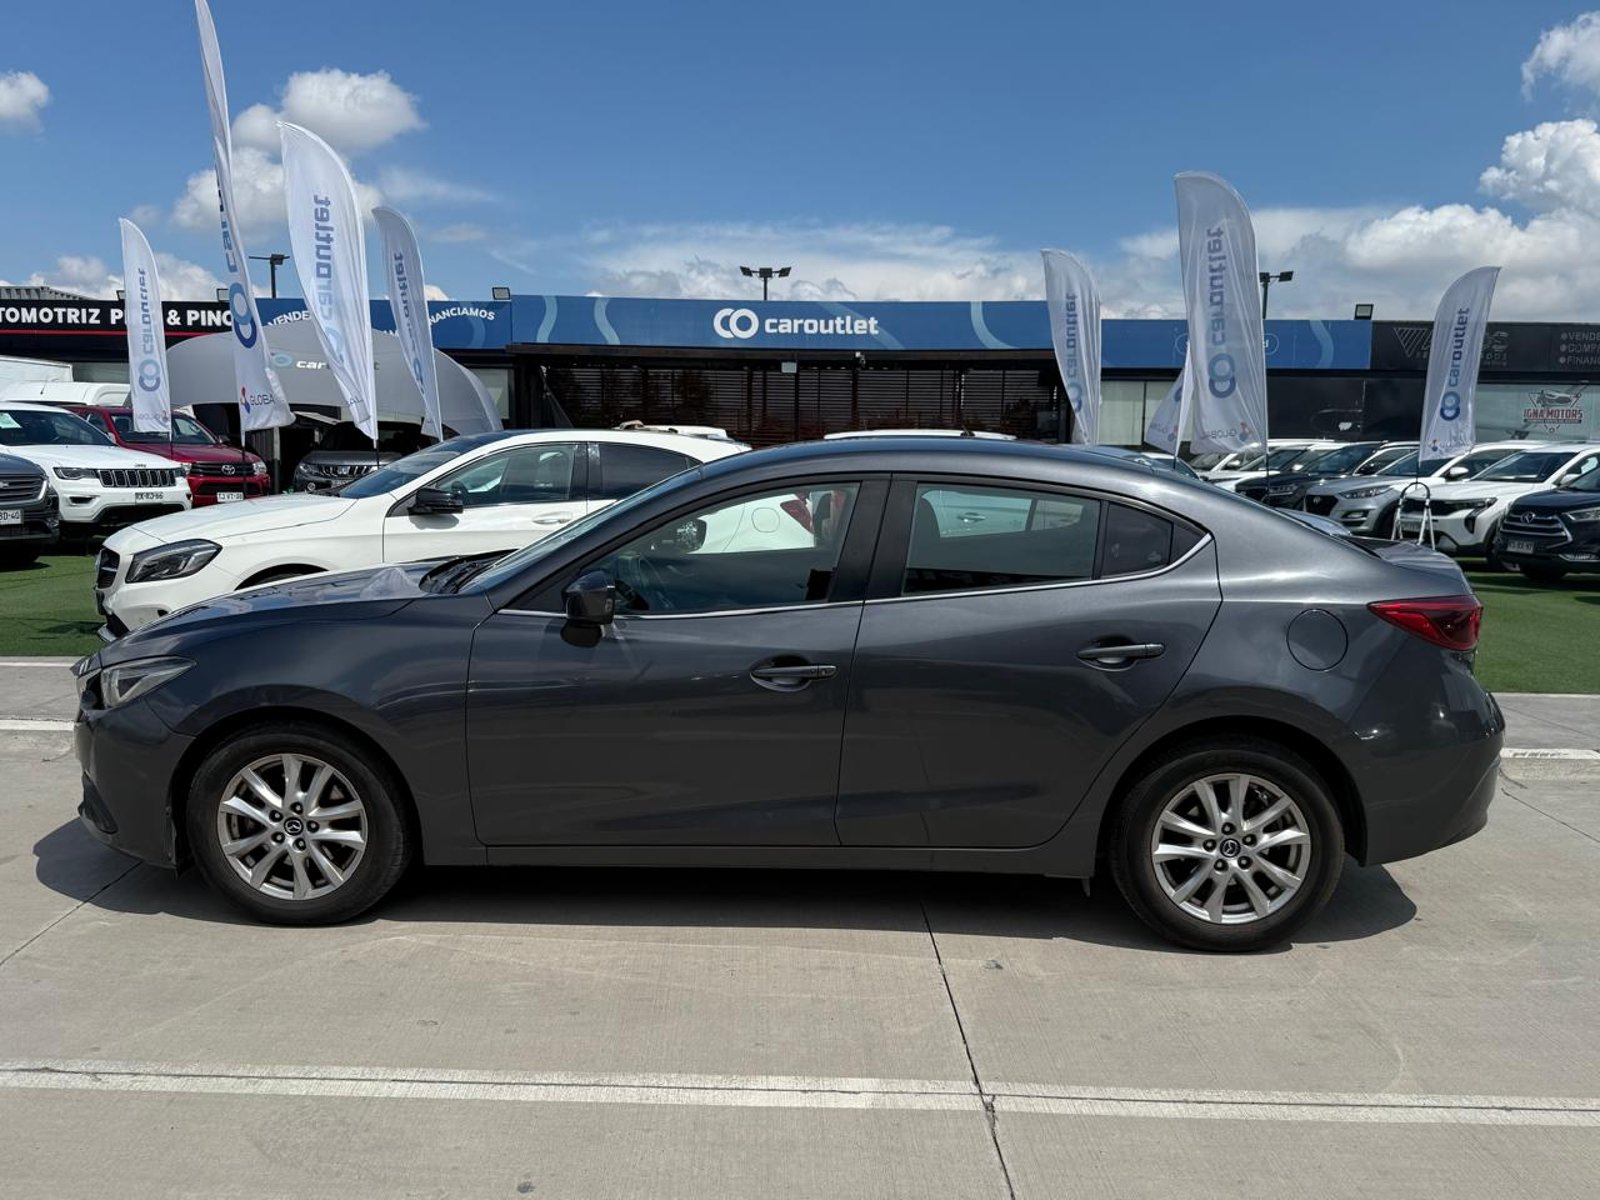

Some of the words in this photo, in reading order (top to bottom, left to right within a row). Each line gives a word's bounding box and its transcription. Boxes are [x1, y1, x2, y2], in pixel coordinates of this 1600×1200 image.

[268, 311, 312, 326] VENDE
[764, 316, 879, 335] caroutlet
[1447, 307, 1470, 388] caroutlet
